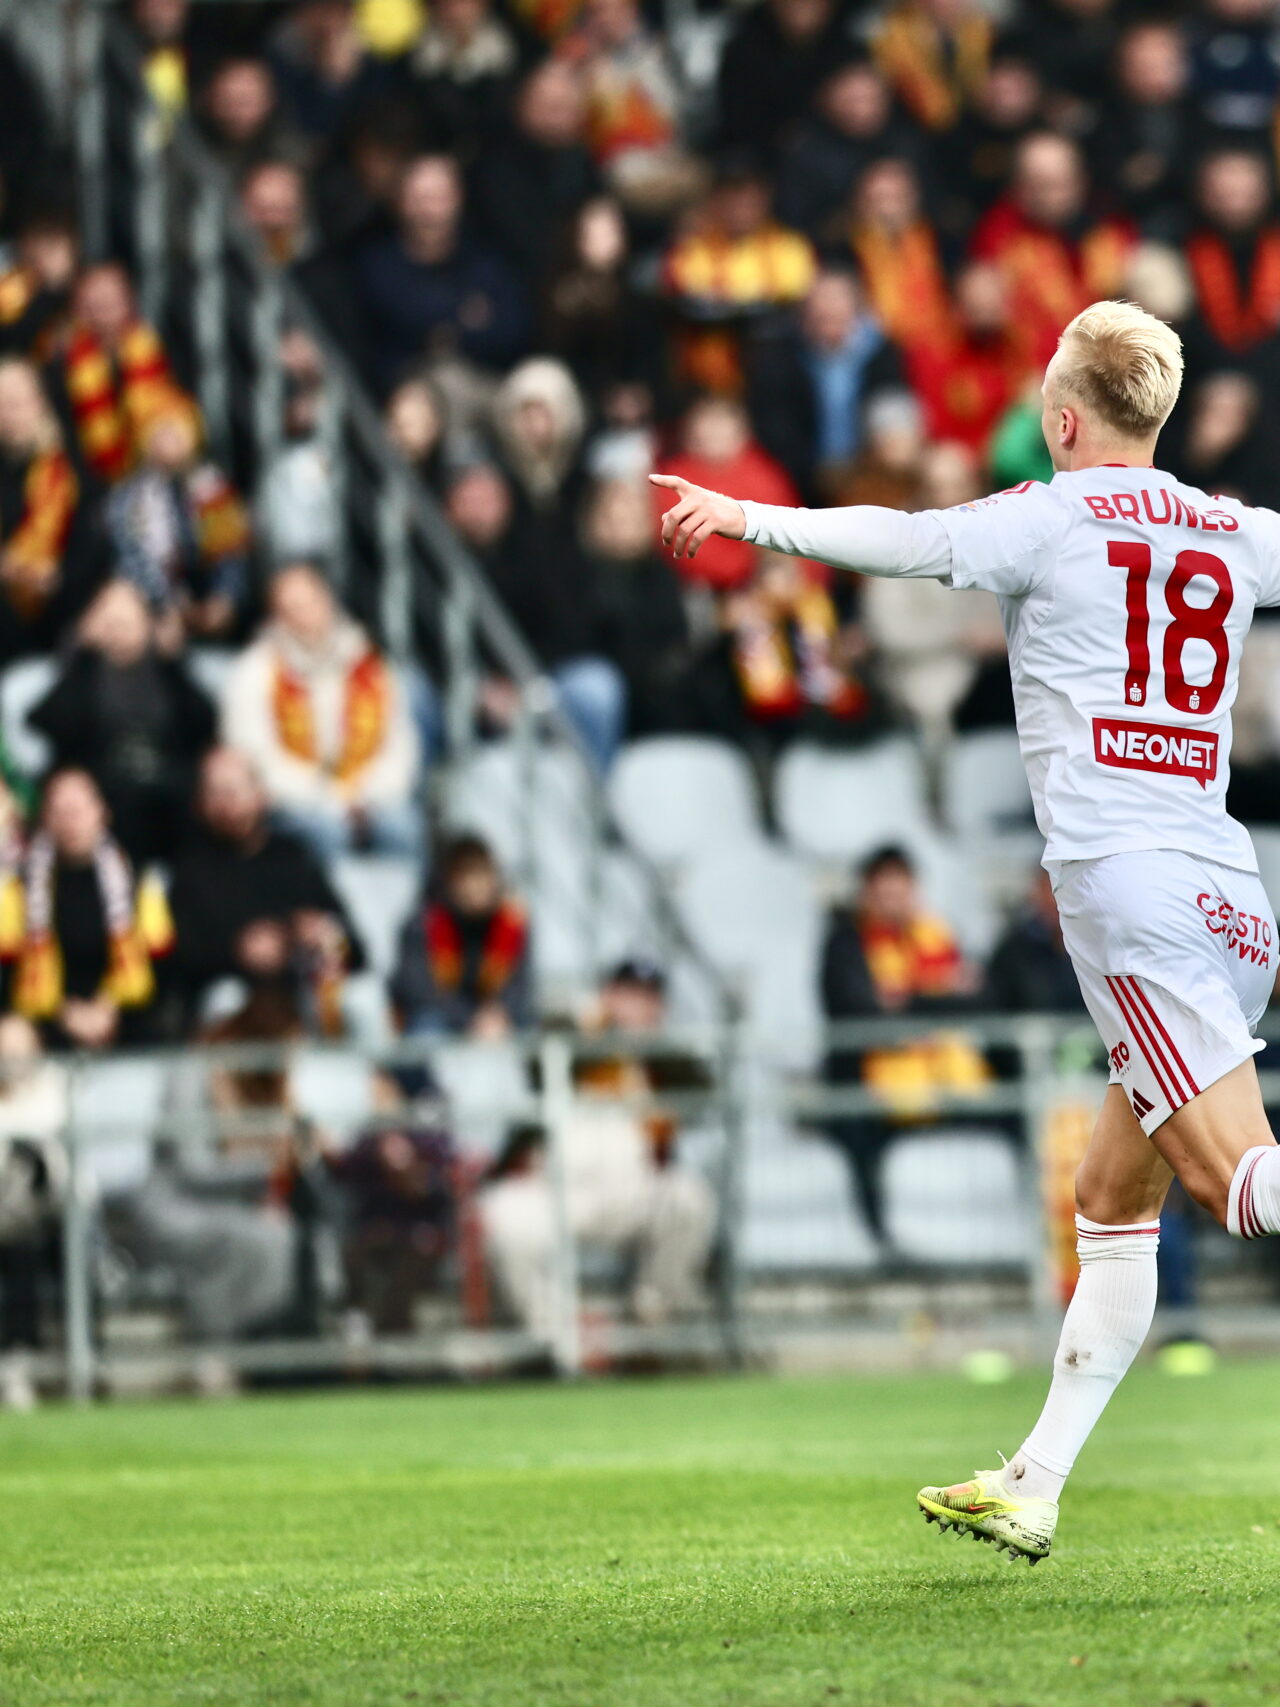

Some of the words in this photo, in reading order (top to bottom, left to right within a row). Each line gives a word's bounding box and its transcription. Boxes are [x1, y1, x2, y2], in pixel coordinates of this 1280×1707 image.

[1084, 489, 1239, 532] BRUNES
[1107, 541, 1234, 715] 18
[1100, 728, 1215, 771] NEONET
